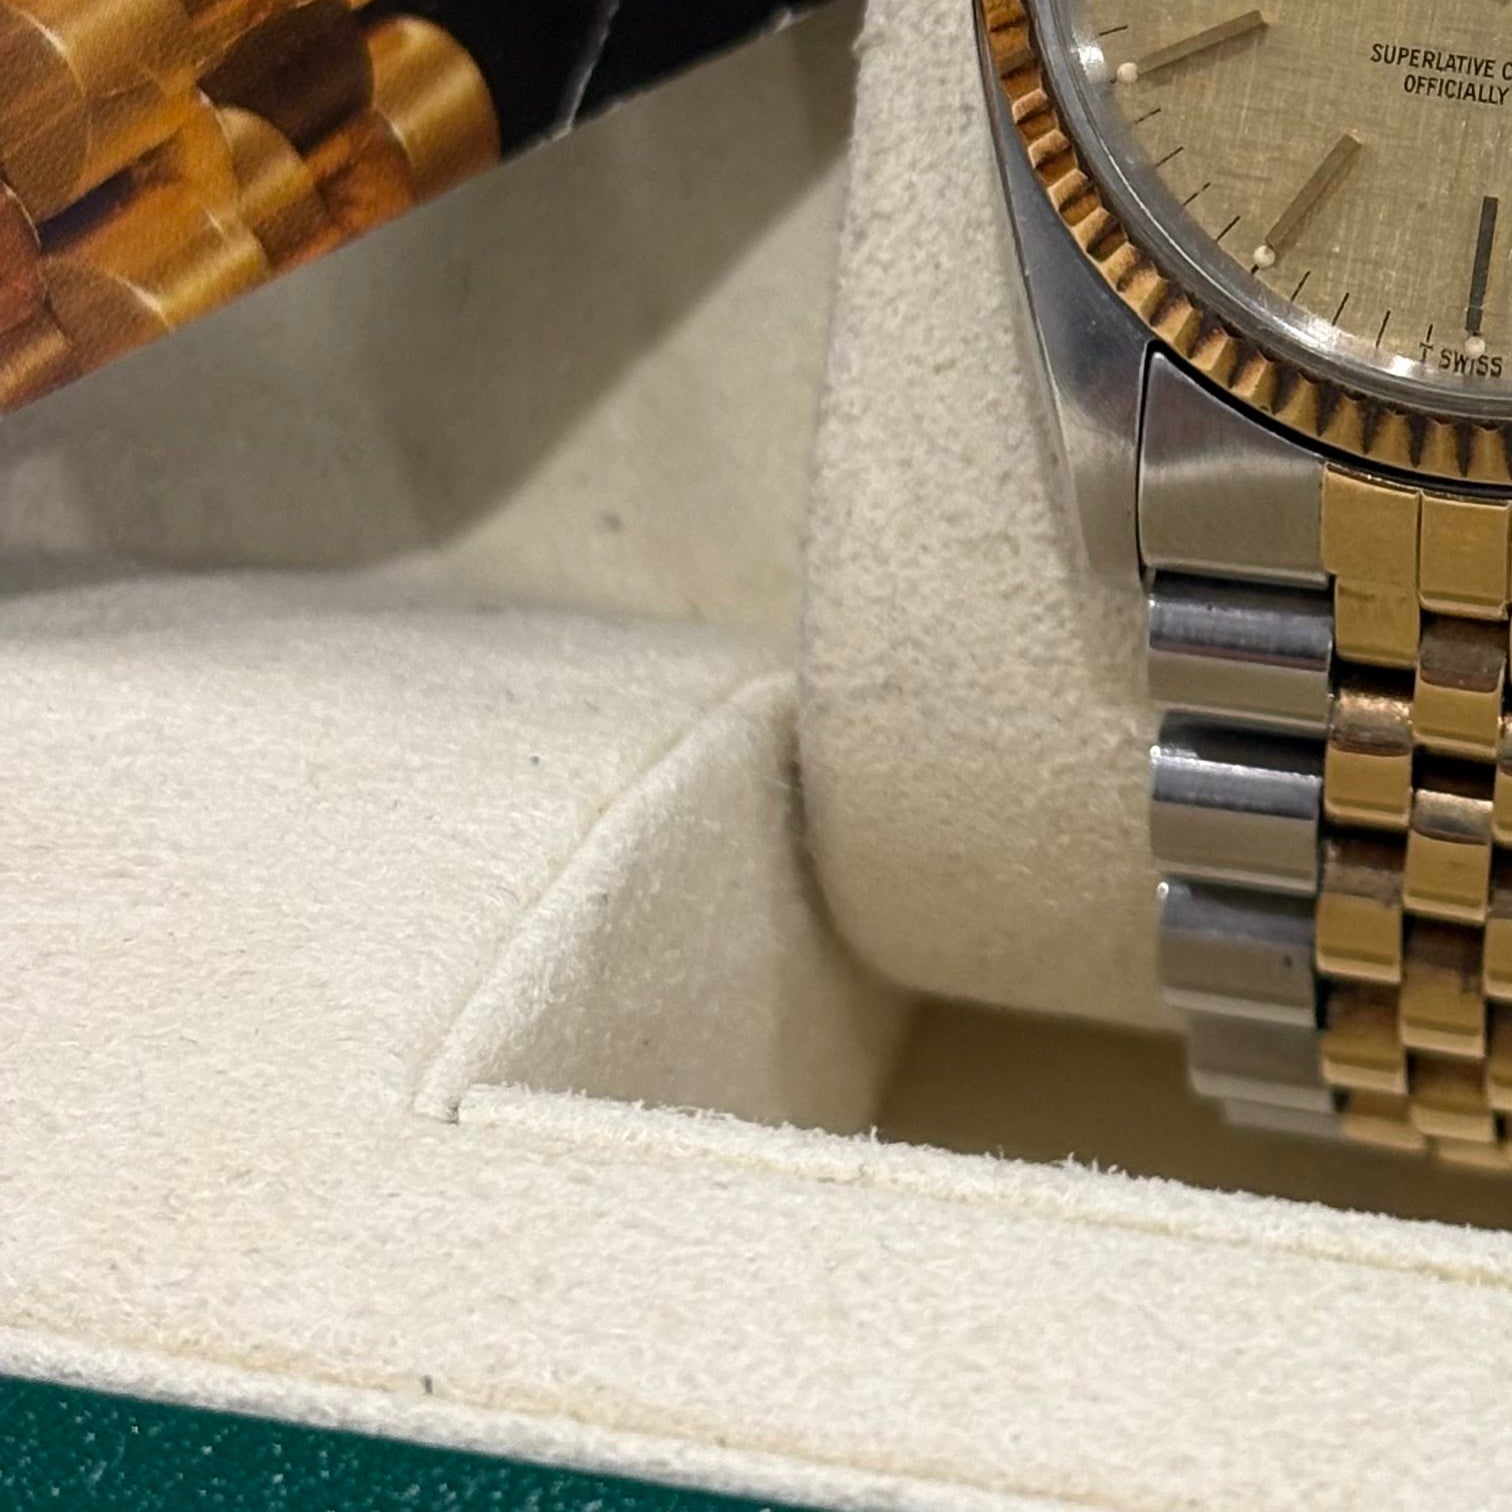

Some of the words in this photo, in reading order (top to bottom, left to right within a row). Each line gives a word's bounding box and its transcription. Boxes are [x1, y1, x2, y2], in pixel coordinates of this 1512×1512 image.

[1371, 43, 1496, 79] SUPERLATIVE
[1404, 75, 1508, 105] OFFICIALLY
[1438, 349, 1503, 378] SWISS
